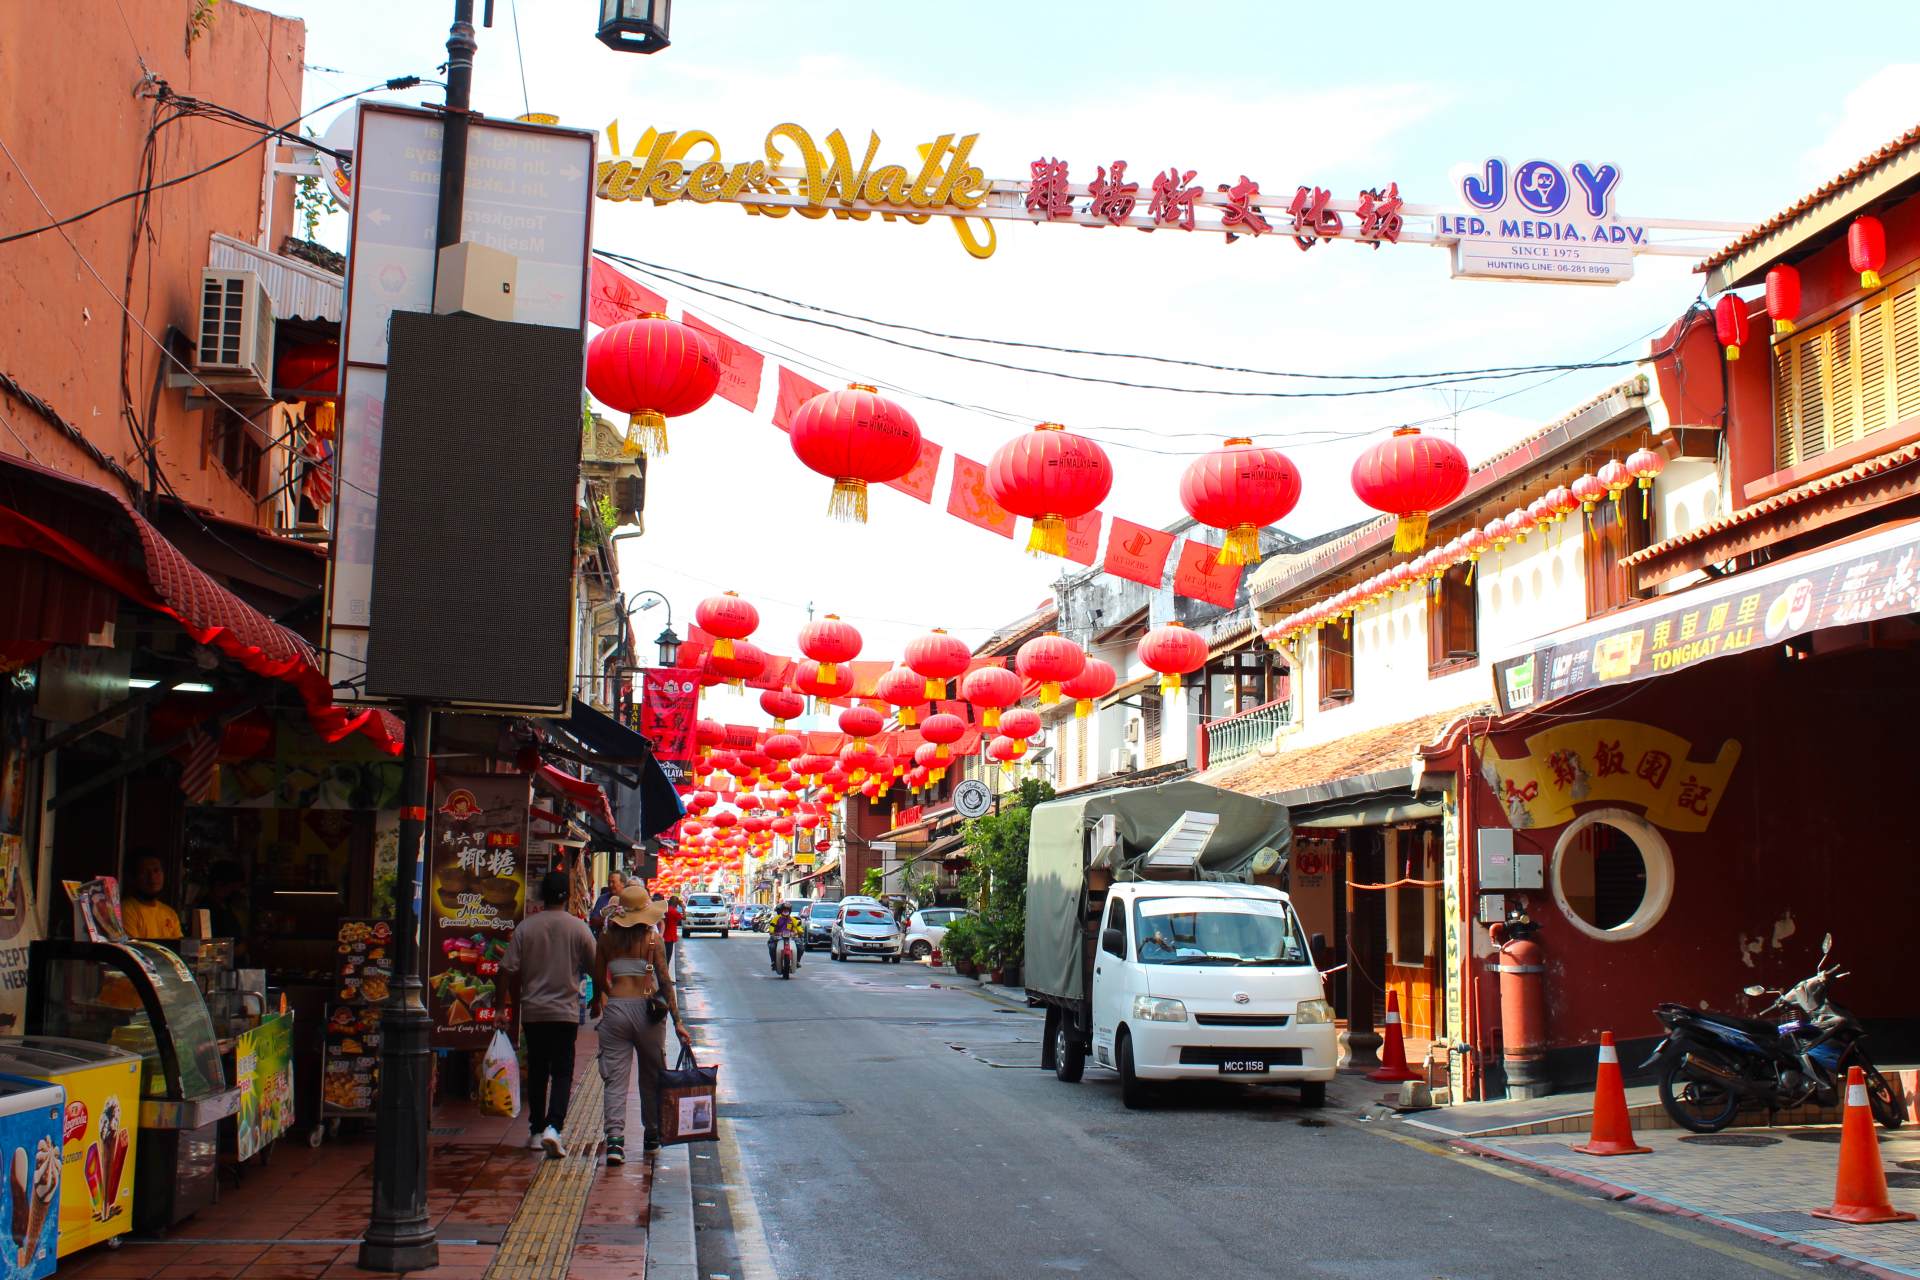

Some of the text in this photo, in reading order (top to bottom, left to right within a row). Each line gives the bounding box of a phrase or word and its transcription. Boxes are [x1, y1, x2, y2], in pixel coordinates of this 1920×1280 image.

[765, 122, 995, 209] Walk
[1463, 158, 1619, 219] JOY
[1591, 224, 1649, 245] ADV.
[1511, 246, 1581, 259] SINCE 1975
[1487, 261, 1530, 270] HUNTING
[1532, 263, 1556, 272] LINE:
[1557, 264, 1587, 273] 06-281
[1652, 626, 1754, 672] TONGKAT ALI
[457, 893, 482, 905] 100%
[456, 903, 499, 918] Melaka
[439, 917, 515, 931] Coconut Palm Sugar
[1446, 886, 1459, 960] AYAM
[2, 969, 30, 990] HER
[1448, 968, 1461, 1024] HOE
[1224, 1061, 1264, 1071] MCC 1158
